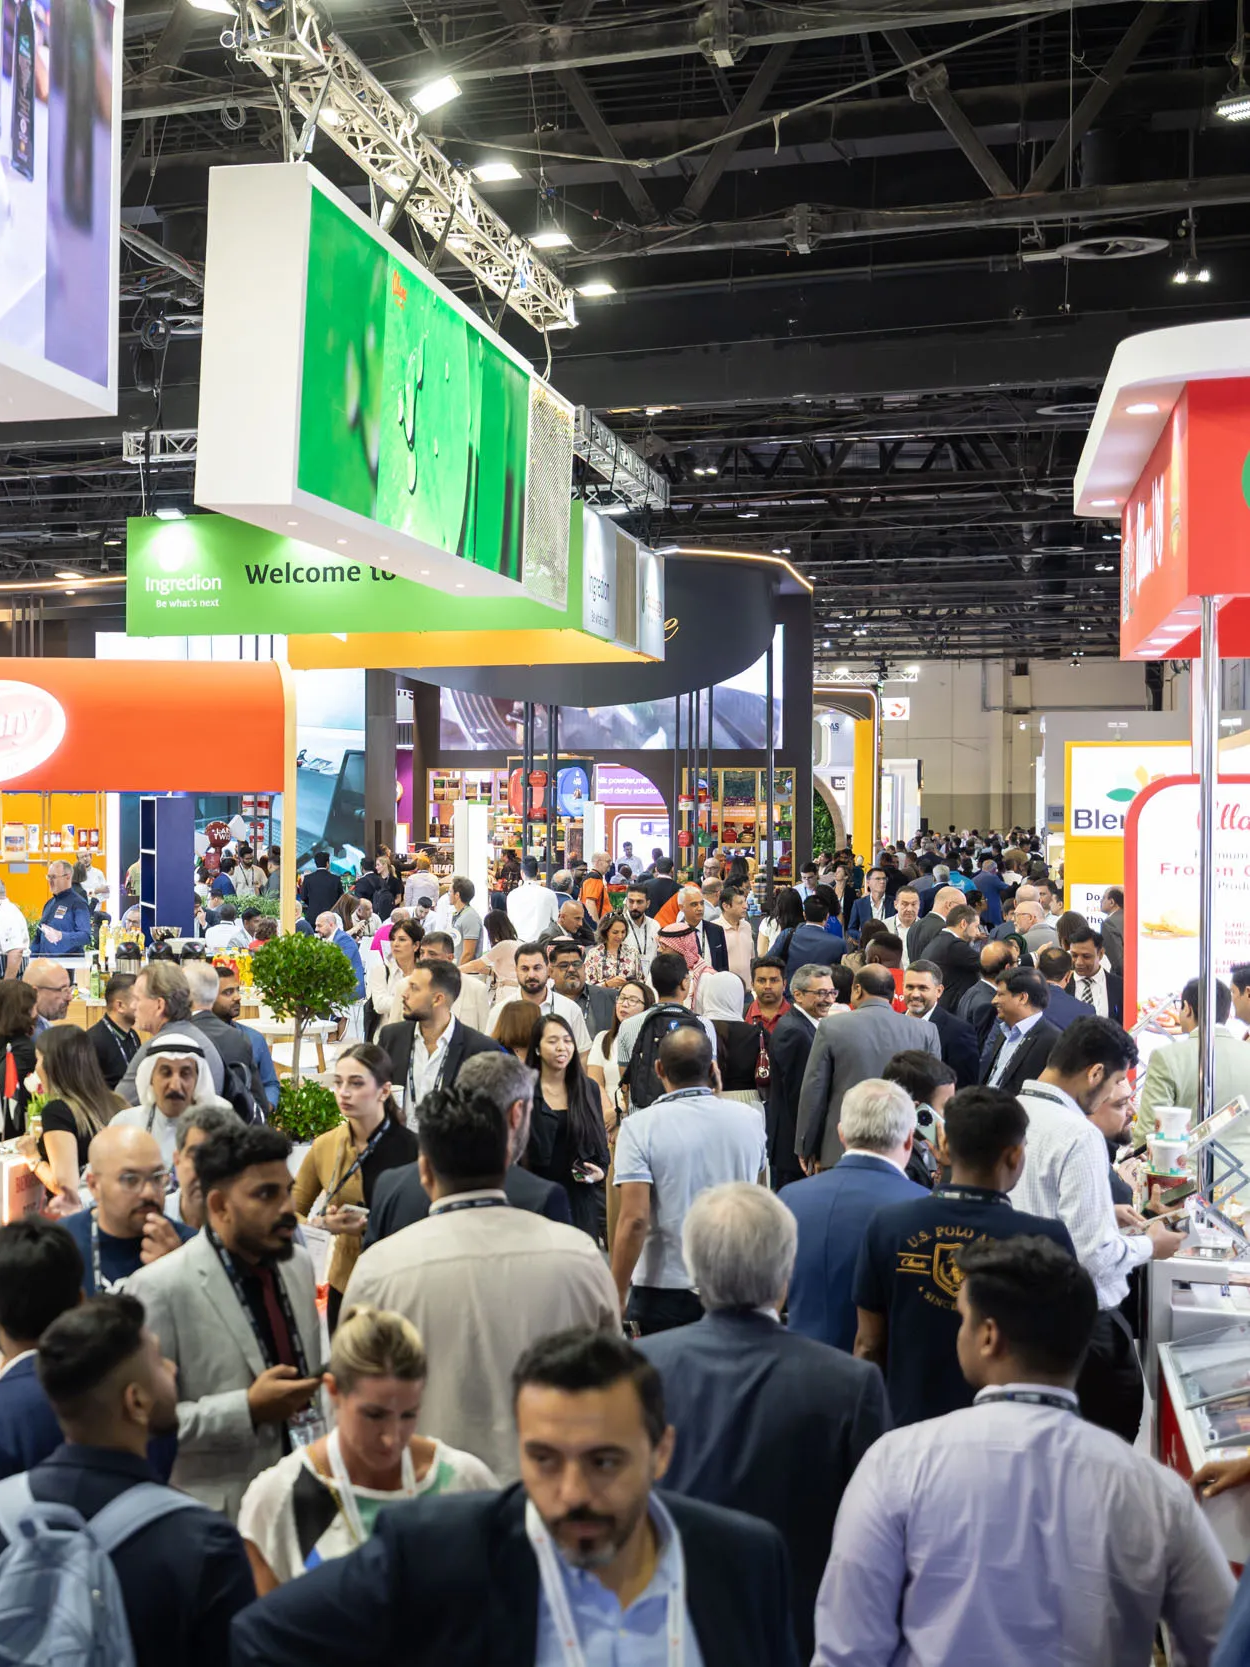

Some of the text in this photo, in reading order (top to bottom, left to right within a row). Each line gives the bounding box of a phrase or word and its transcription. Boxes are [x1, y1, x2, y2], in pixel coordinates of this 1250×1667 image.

[245, 562, 397, 585] Welcome to
[145, 574, 222, 595] Ingredion
[156, 598, 219, 608] Be what's next
[1160, 862, 1233, 876] Fron
[935, 1226, 974, 1238] POLO
